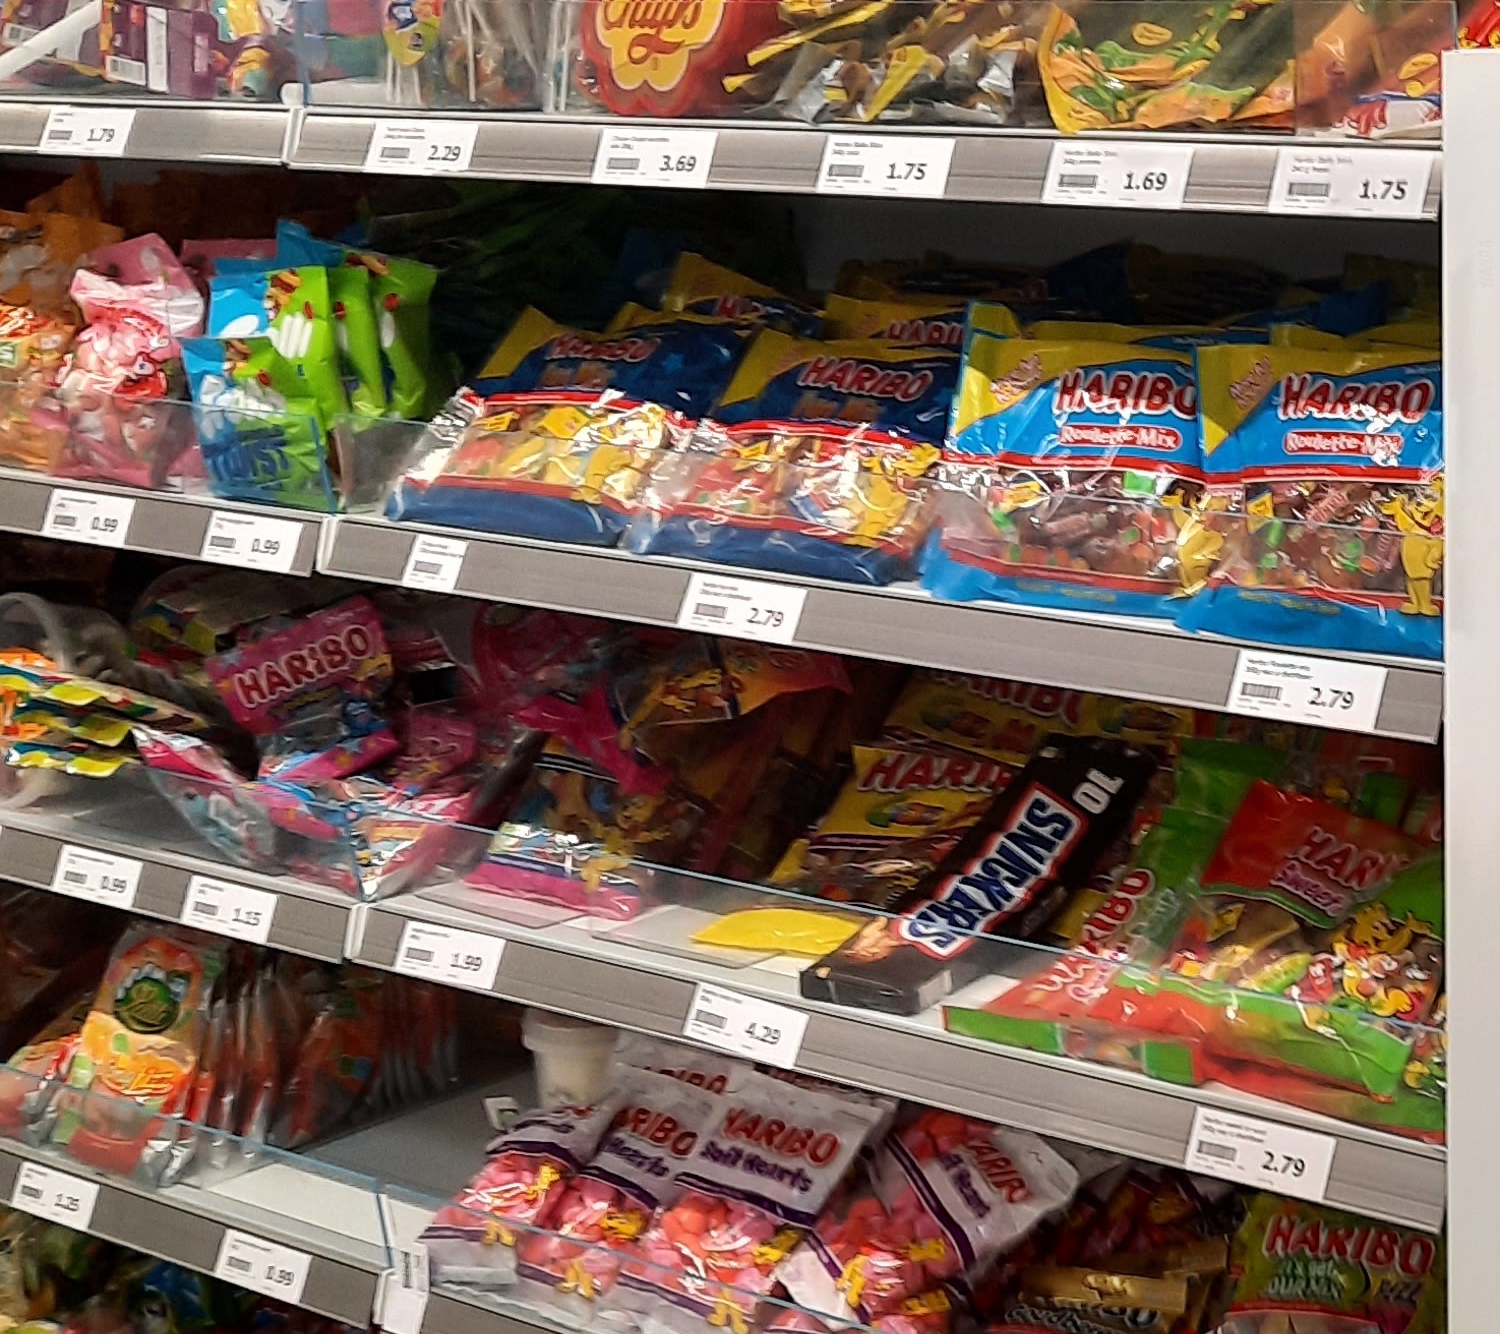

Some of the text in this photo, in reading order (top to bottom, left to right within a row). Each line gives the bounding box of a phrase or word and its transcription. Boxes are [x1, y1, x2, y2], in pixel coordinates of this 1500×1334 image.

[658, 154, 697, 173] 3.69
[886, 162, 927, 181] 1.75
[1122, 171, 1168, 191] 1.69
[1358, 180, 1408, 201] 1.75
[799, 355, 932, 401] HARIBO
[1055, 369, 1198, 417] HARIBO
[1278, 373, 1435, 427] HARIBO
[745, 607, 784, 628] 2.79
[234, 624, 371, 708] HARIBO
[1307, 686, 1354, 710] 2.79
[905, 795, 1077, 954] SNICKERS
[1262, 1151, 1305, 1177] 2.79
[1263, 1215, 1435, 1278] HARIBO
